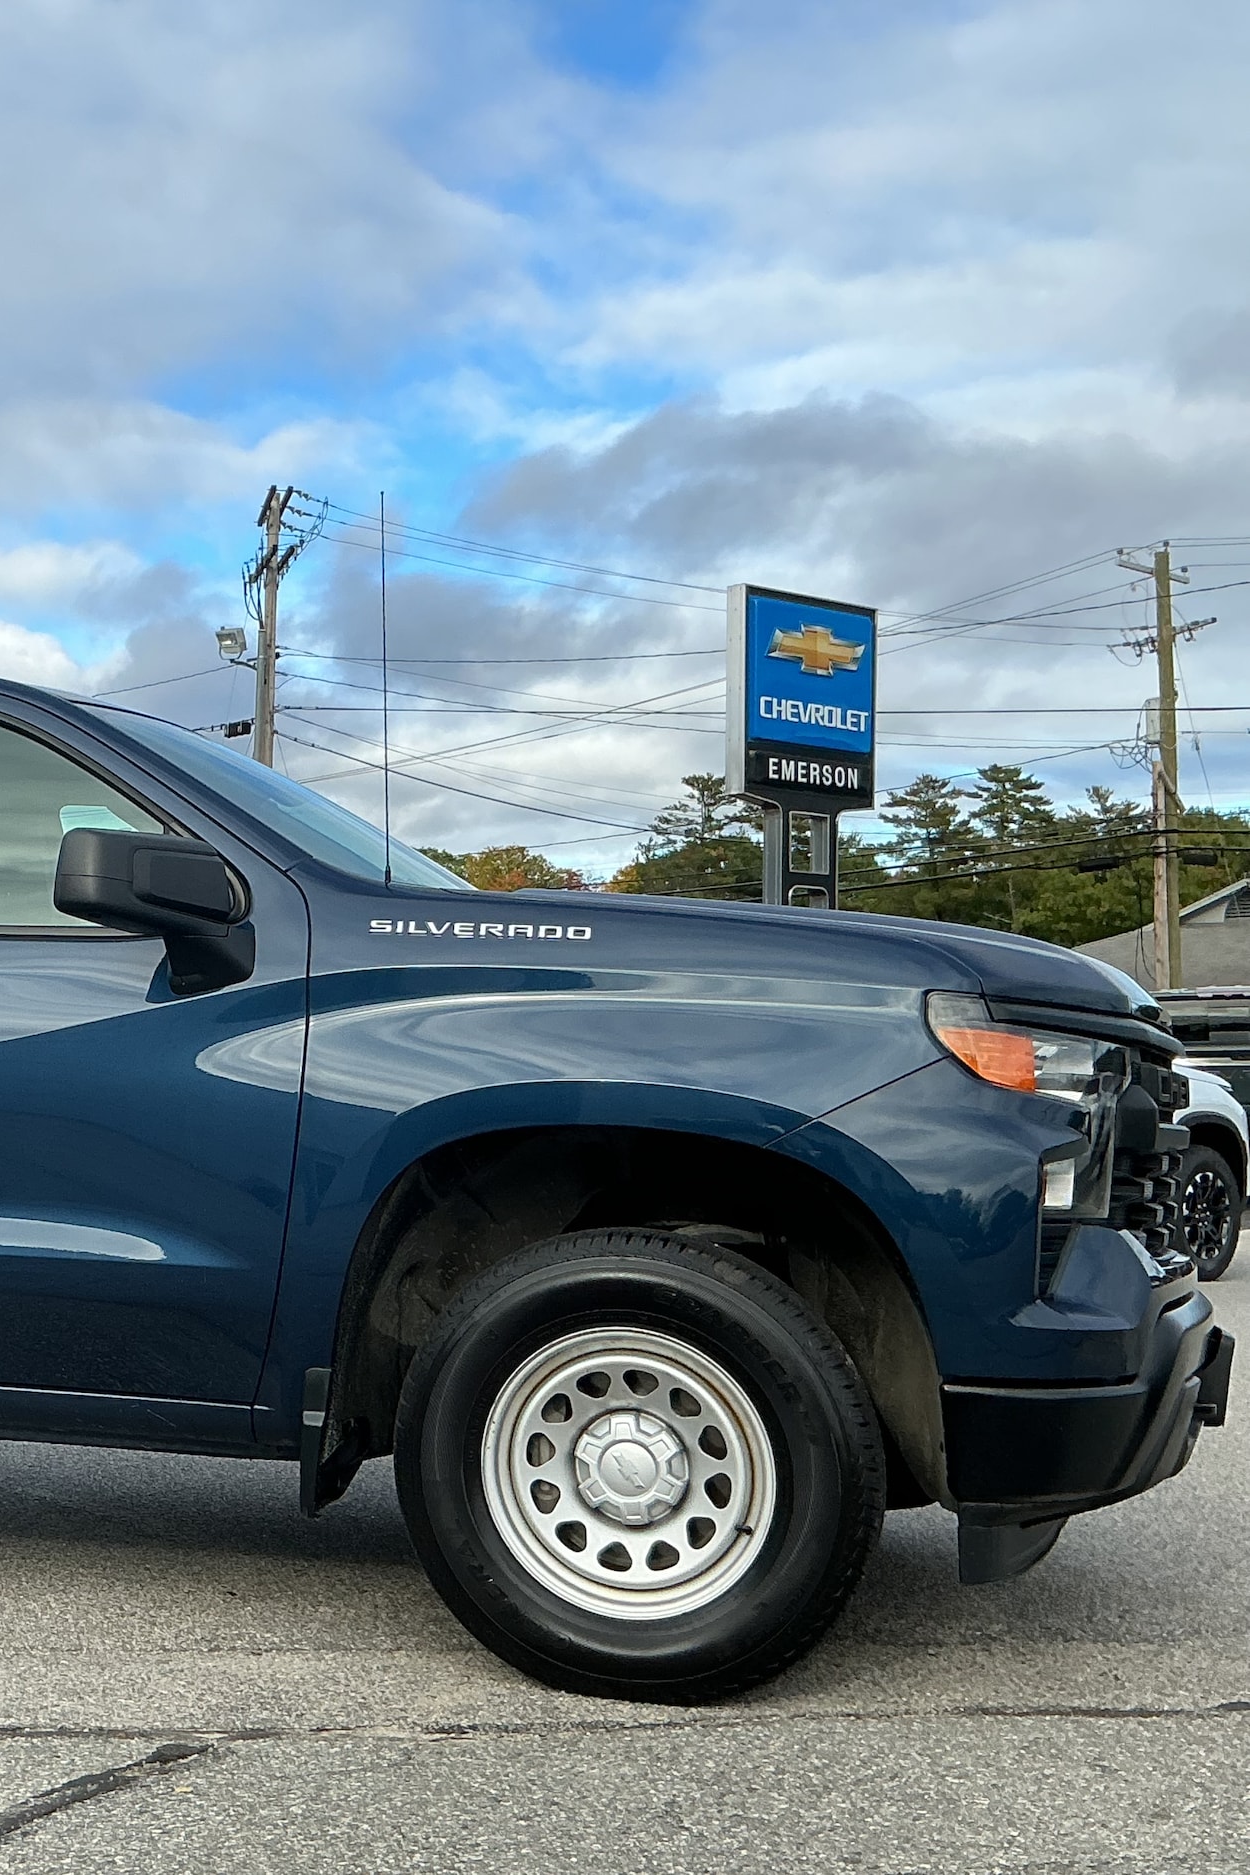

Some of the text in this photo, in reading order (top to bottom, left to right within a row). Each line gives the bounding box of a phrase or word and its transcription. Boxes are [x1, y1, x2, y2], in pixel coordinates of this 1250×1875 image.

[759, 695, 869, 733] CHEVROLET
[768, 757, 858, 790] EMERSON
[368, 918, 593, 941] SILVERADO
